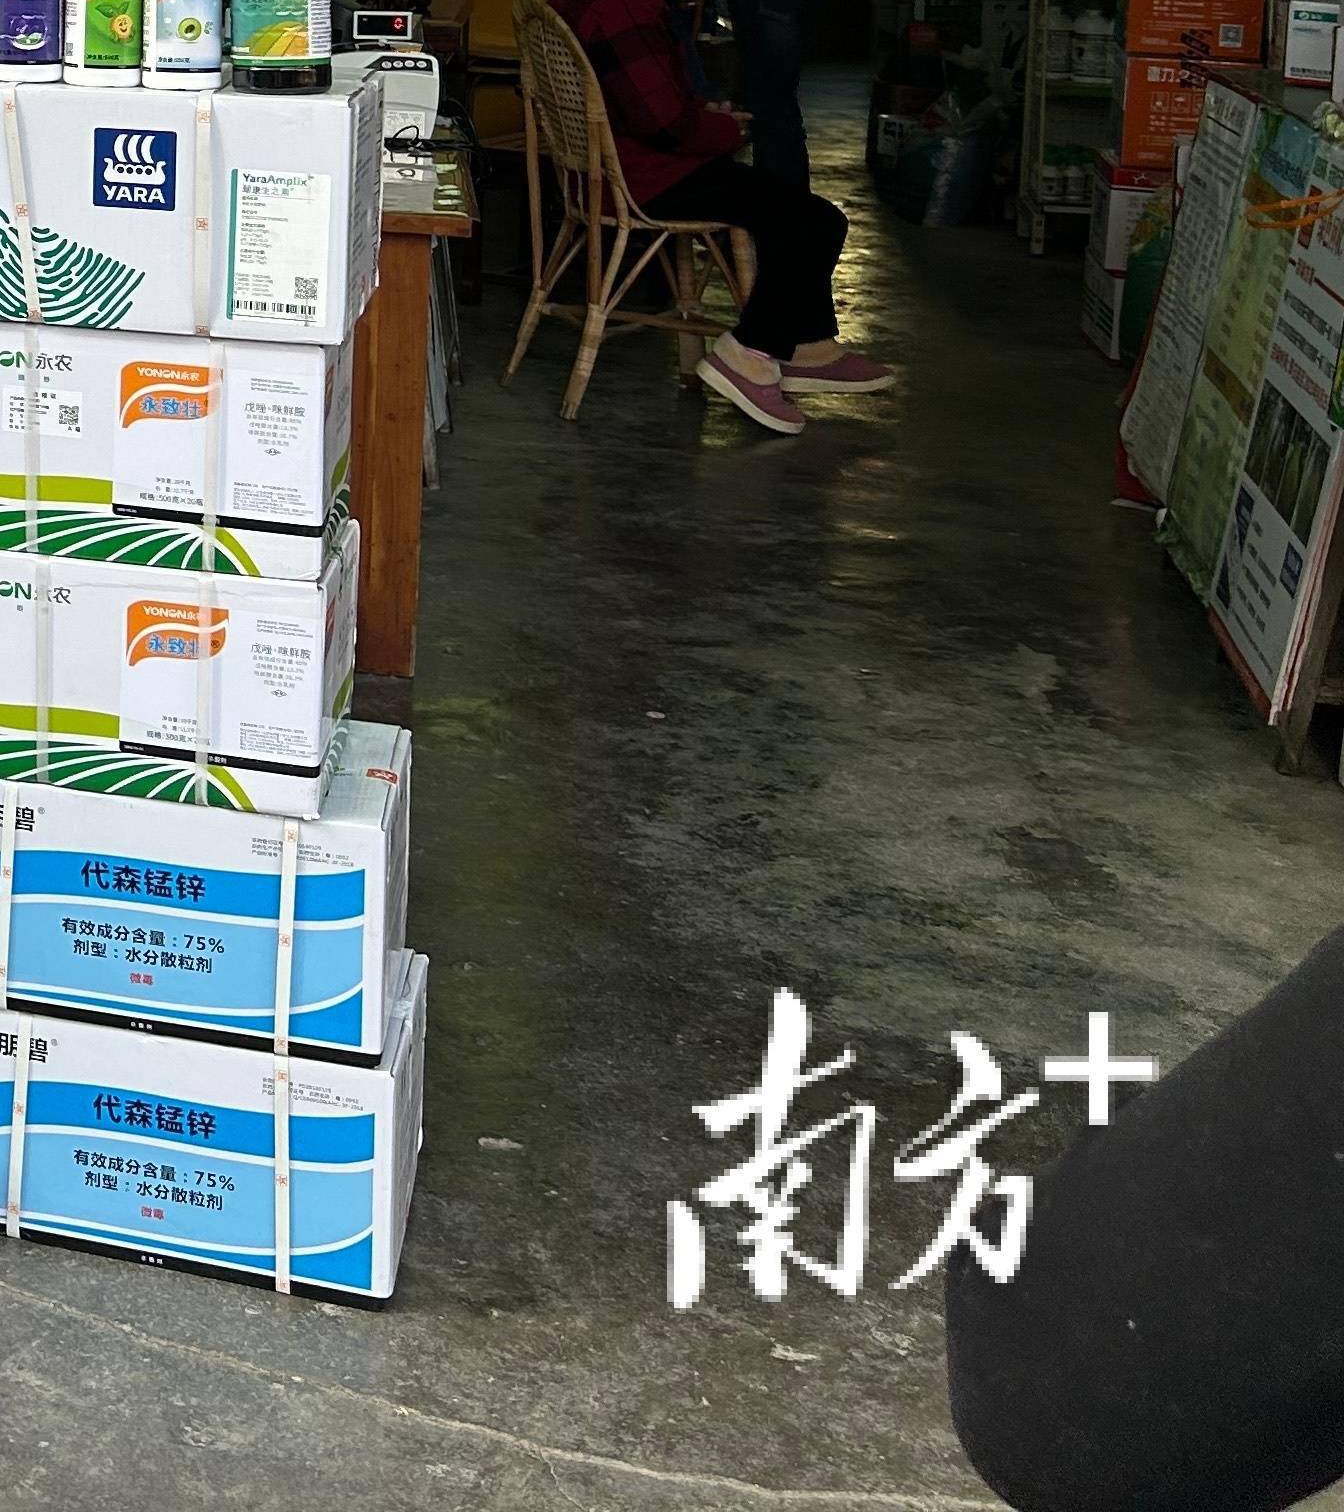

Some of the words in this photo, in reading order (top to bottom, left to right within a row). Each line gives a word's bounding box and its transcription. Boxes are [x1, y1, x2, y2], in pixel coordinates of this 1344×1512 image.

[103, 185, 165, 204] YARA
[243, 173, 308, 186] YaraAmplix
[80, 860, 206, 903] 代森锰锌
[93, 1092, 217, 1139] 代森锰锌
